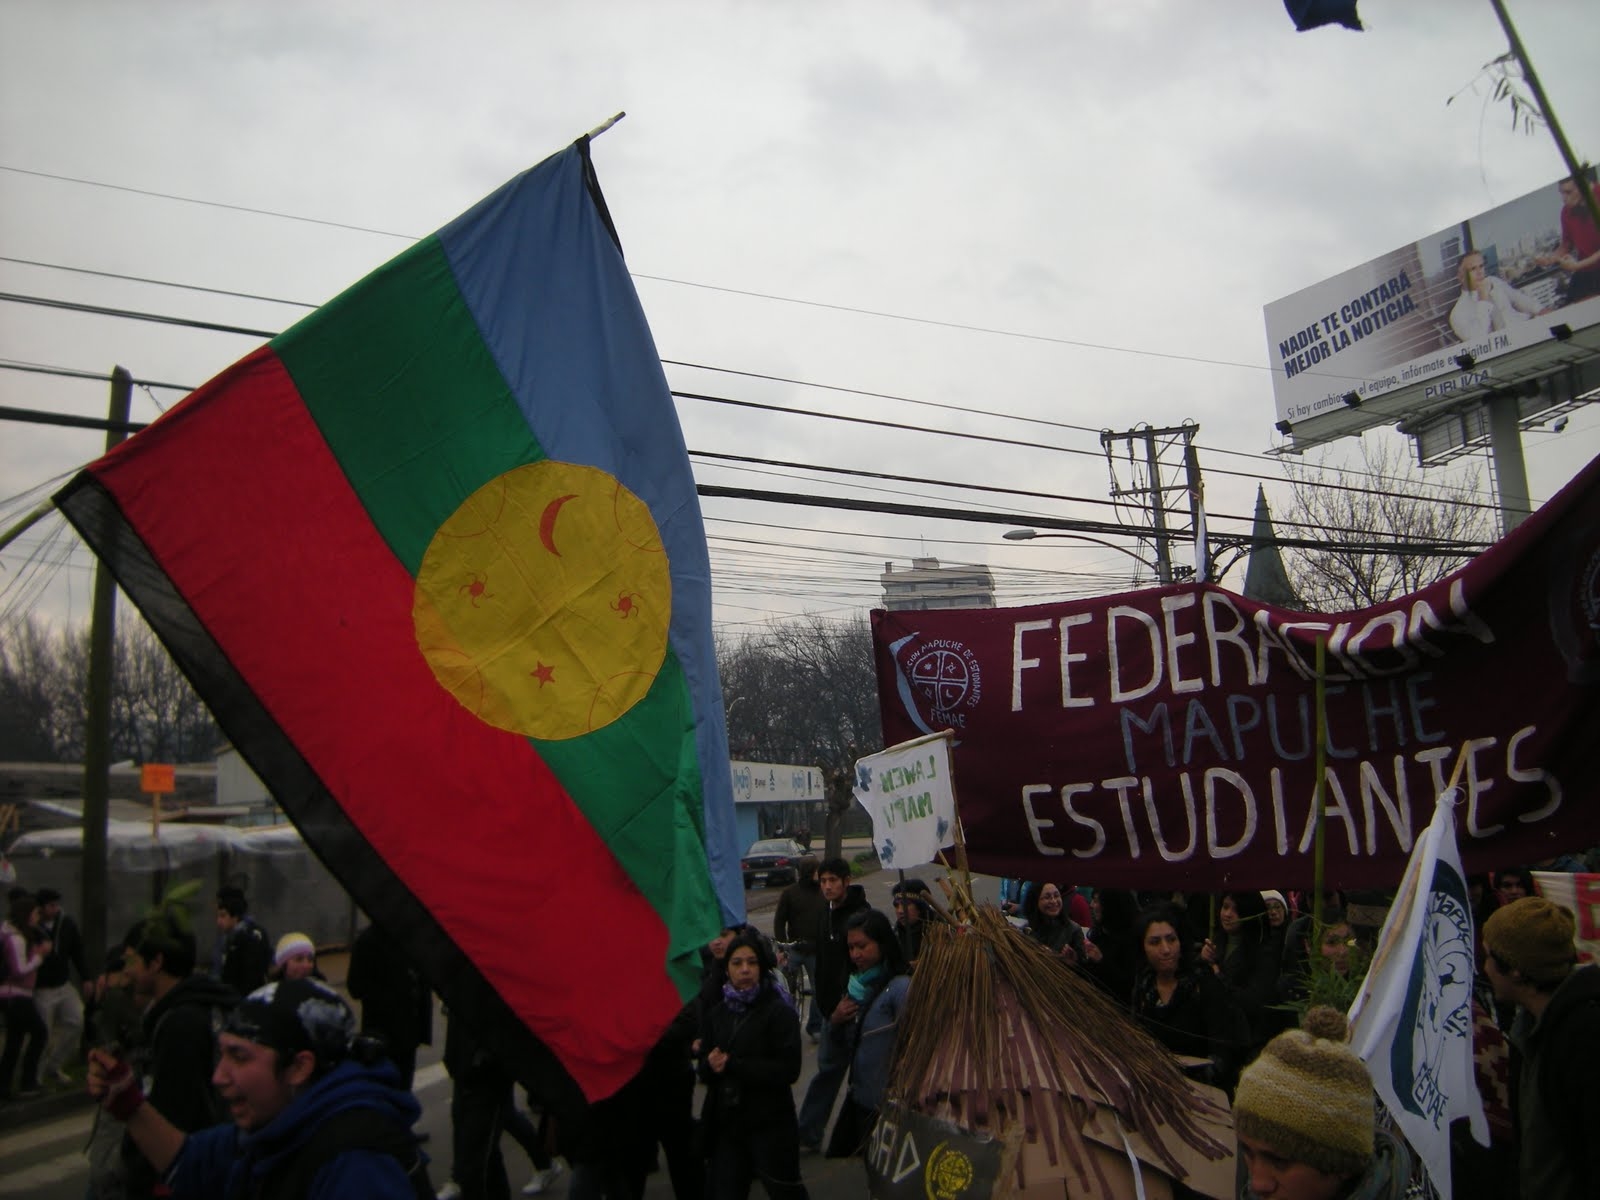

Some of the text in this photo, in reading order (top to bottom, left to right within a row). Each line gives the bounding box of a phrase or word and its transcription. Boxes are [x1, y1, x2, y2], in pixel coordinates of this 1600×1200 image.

[1278, 270, 1412, 359] NADIE TE CONTARÁ
[1283, 294, 1419, 379] MEJOR LA NOTICIA.
[1287, 407, 1295, 420] Si
[1313, 392, 1345, 411] cambios
[1358, 381, 1367, 395] el
[921, 639, 963, 654] MAPUCHE
[962, 649, 974, 660] DE
[1011, 578, 1495, 711] FEDERACION
[930, 707, 966, 729] FEMAE
[1118, 672, 1447, 773] MAPUCHE
[1021, 725, 1563, 861] ESTUDIANTES
